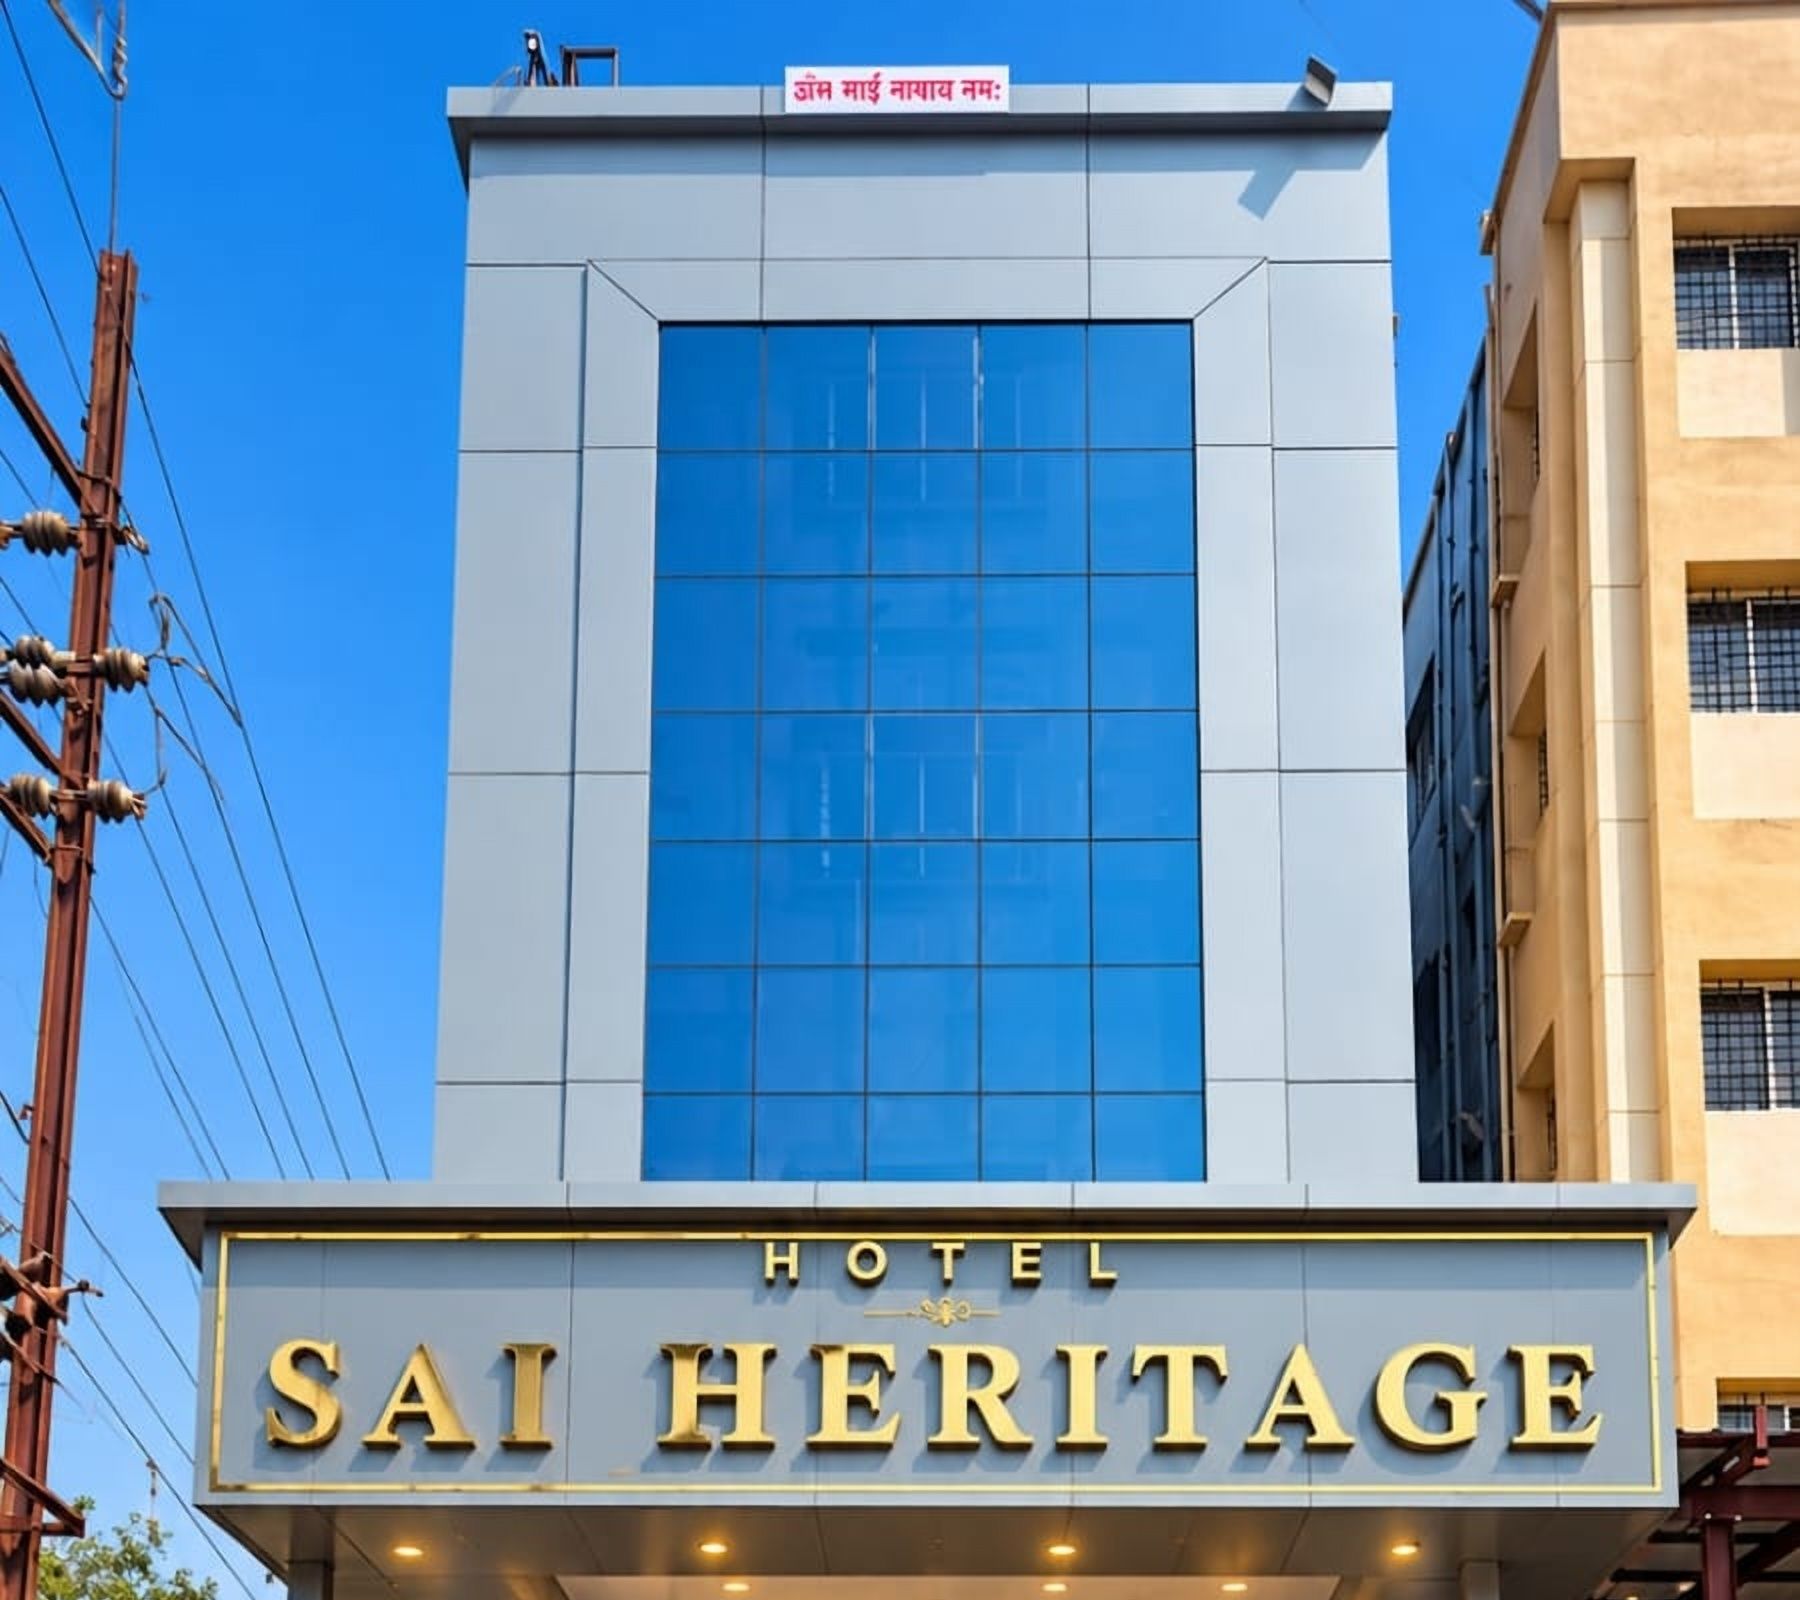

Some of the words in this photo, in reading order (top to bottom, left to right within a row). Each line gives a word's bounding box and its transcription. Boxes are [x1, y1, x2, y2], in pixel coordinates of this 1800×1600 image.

[763, 1241, 1118, 1288] HOTEL
[266, 1338, 558, 1451] SAI
[657, 1342, 1603, 1452] HERITAGE
